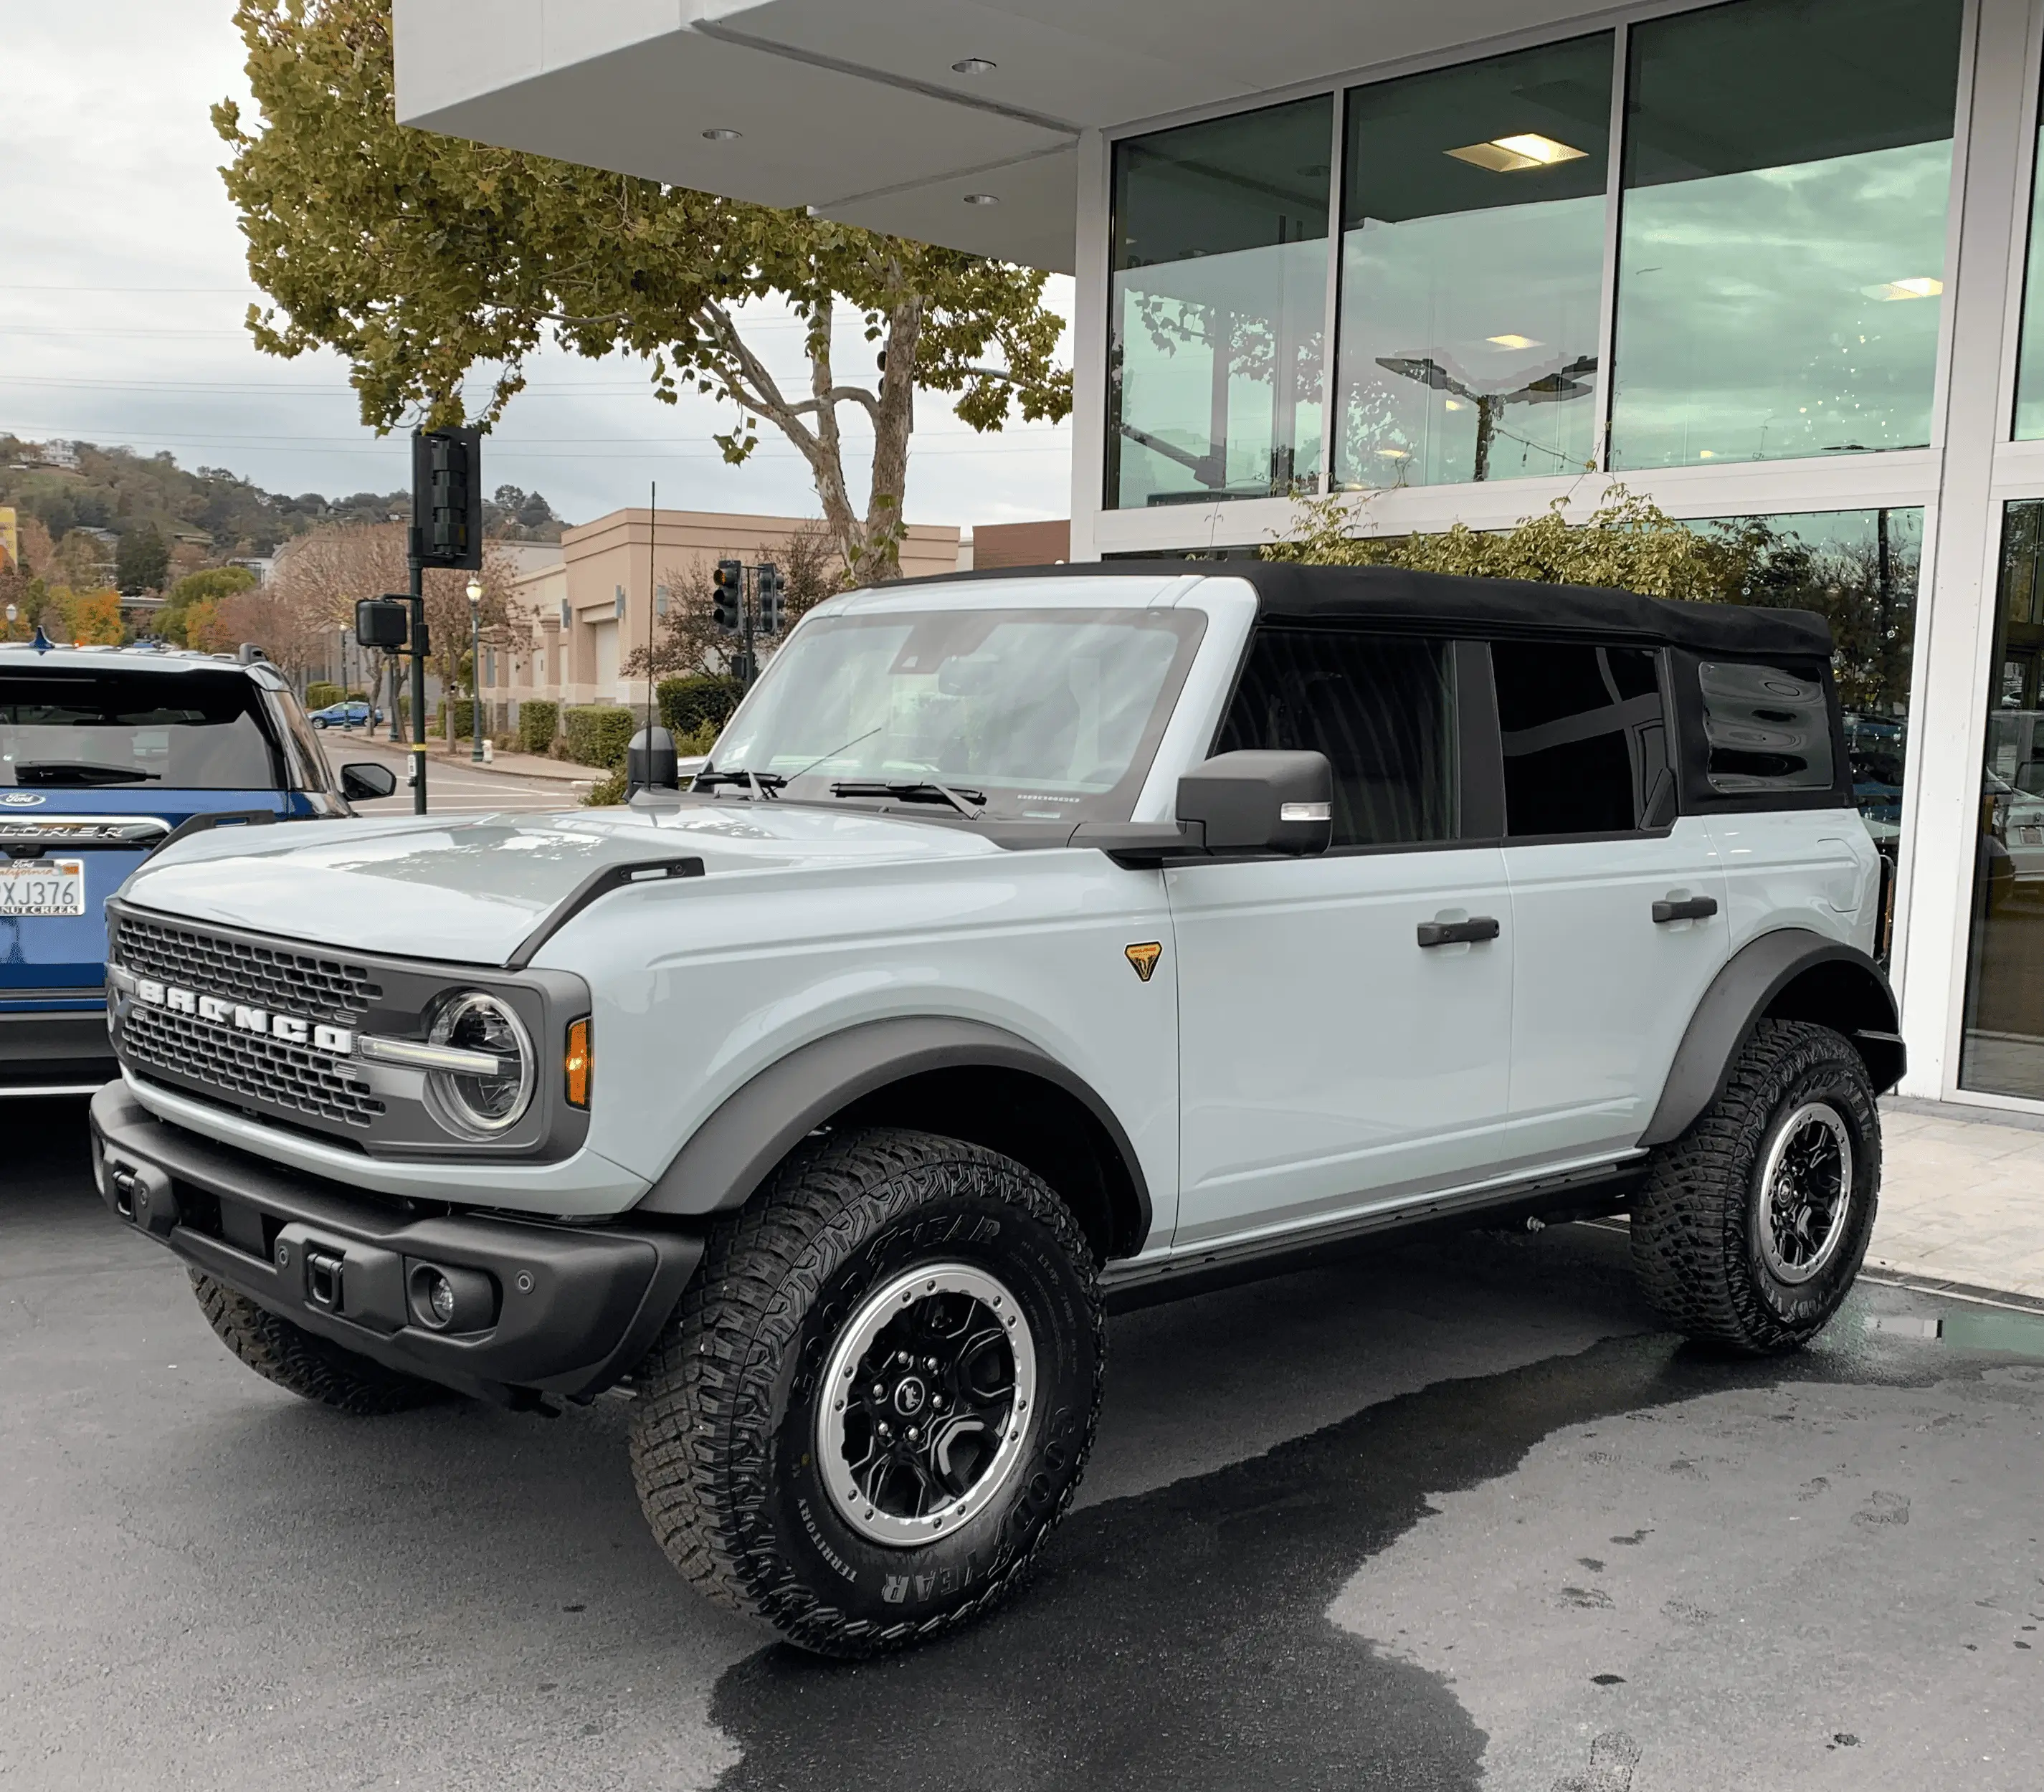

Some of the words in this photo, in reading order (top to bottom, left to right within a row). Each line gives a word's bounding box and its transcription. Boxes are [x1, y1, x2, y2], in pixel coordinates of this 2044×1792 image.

[6, 794, 34, 803] Ford
[11, 859, 34, 868] Ford
[0, 882, 74, 905] XJ376
[31, 906, 77, 915] CREEK
[140, 979, 351, 1054] BRONCO
[797, 1498, 857, 1583] TERRITORY
